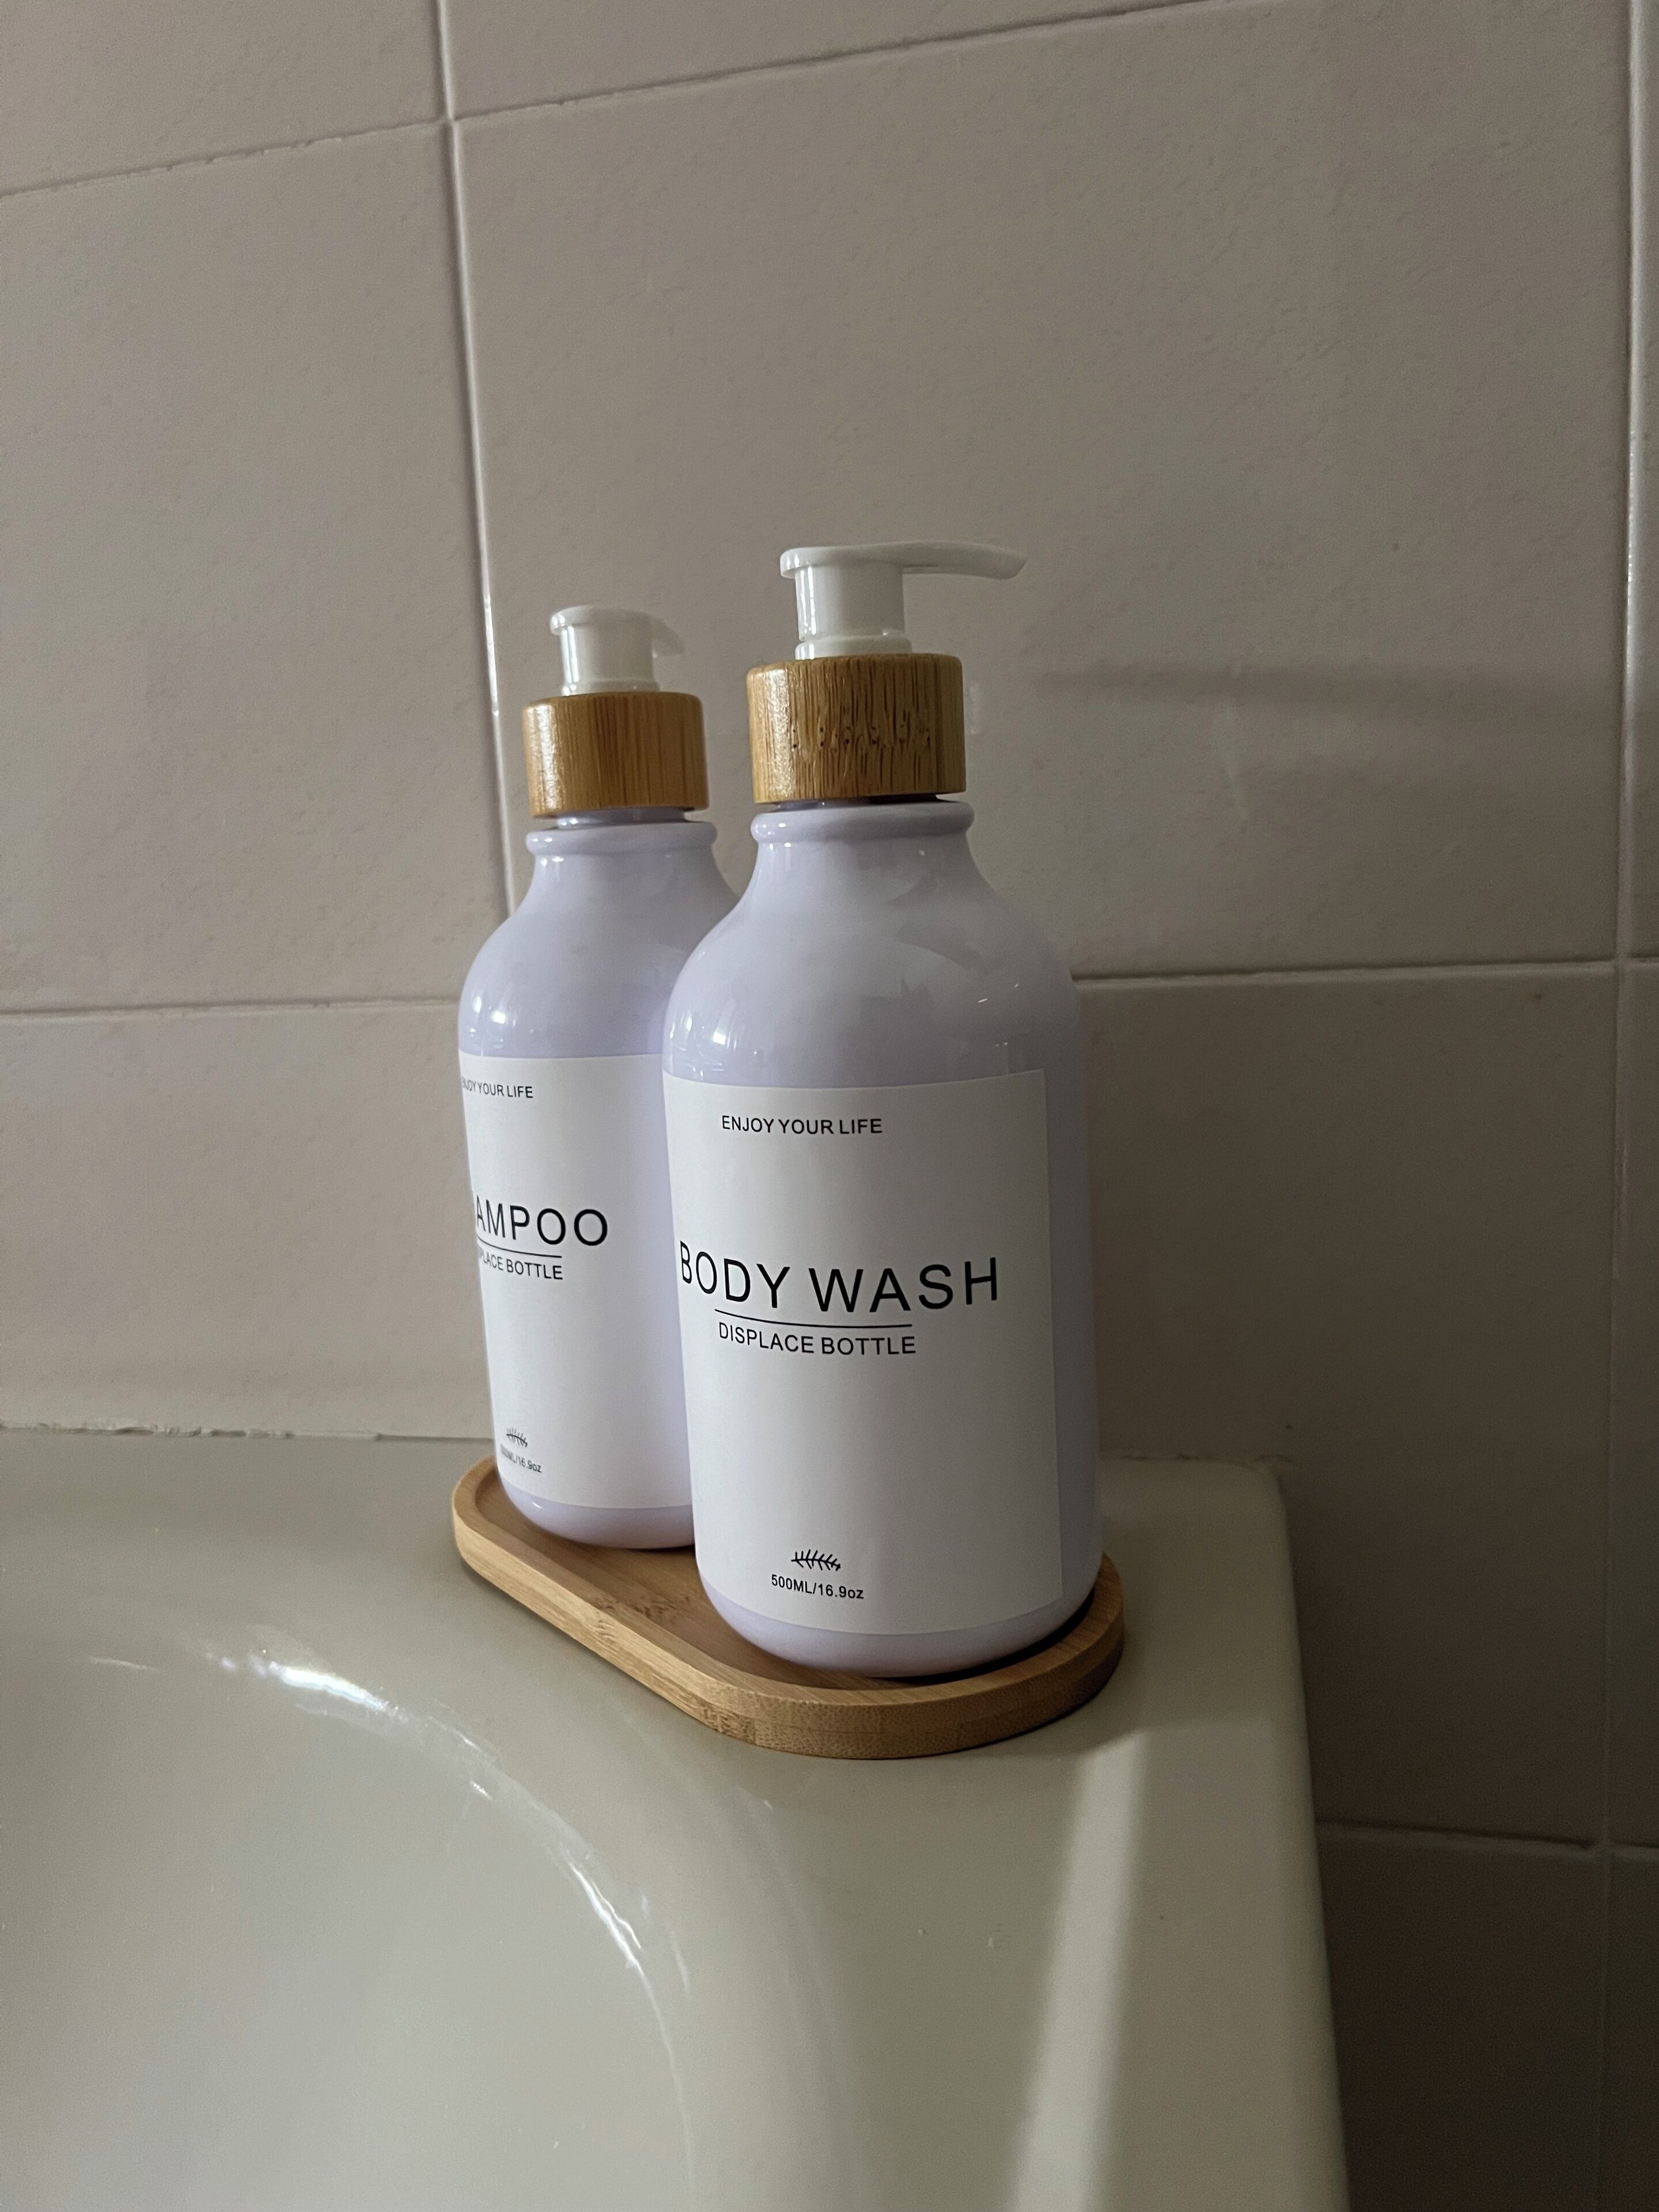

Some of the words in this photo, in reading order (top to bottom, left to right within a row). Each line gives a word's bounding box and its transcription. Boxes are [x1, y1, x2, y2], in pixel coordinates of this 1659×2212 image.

[477, 1082, 505, 1097] YOUR
[506, 1085, 534, 1099] LIFE
[722, 1115, 775, 1134] ENJOY
[778, 1119, 834, 1135] YOUR
[839, 1118, 883, 1134] LIFE
[477, 1194, 608, 1246] AMPOO
[506, 1259, 563, 1280] BOTTLE
[680, 1240, 790, 1309] BODY
[808, 1256, 998, 1313] WASH
[719, 1321, 815, 1354] DISPLACE
[821, 1336, 916, 1355] BOTTLE
[771, 1574, 864, 1599] 500ML/16.9oz
